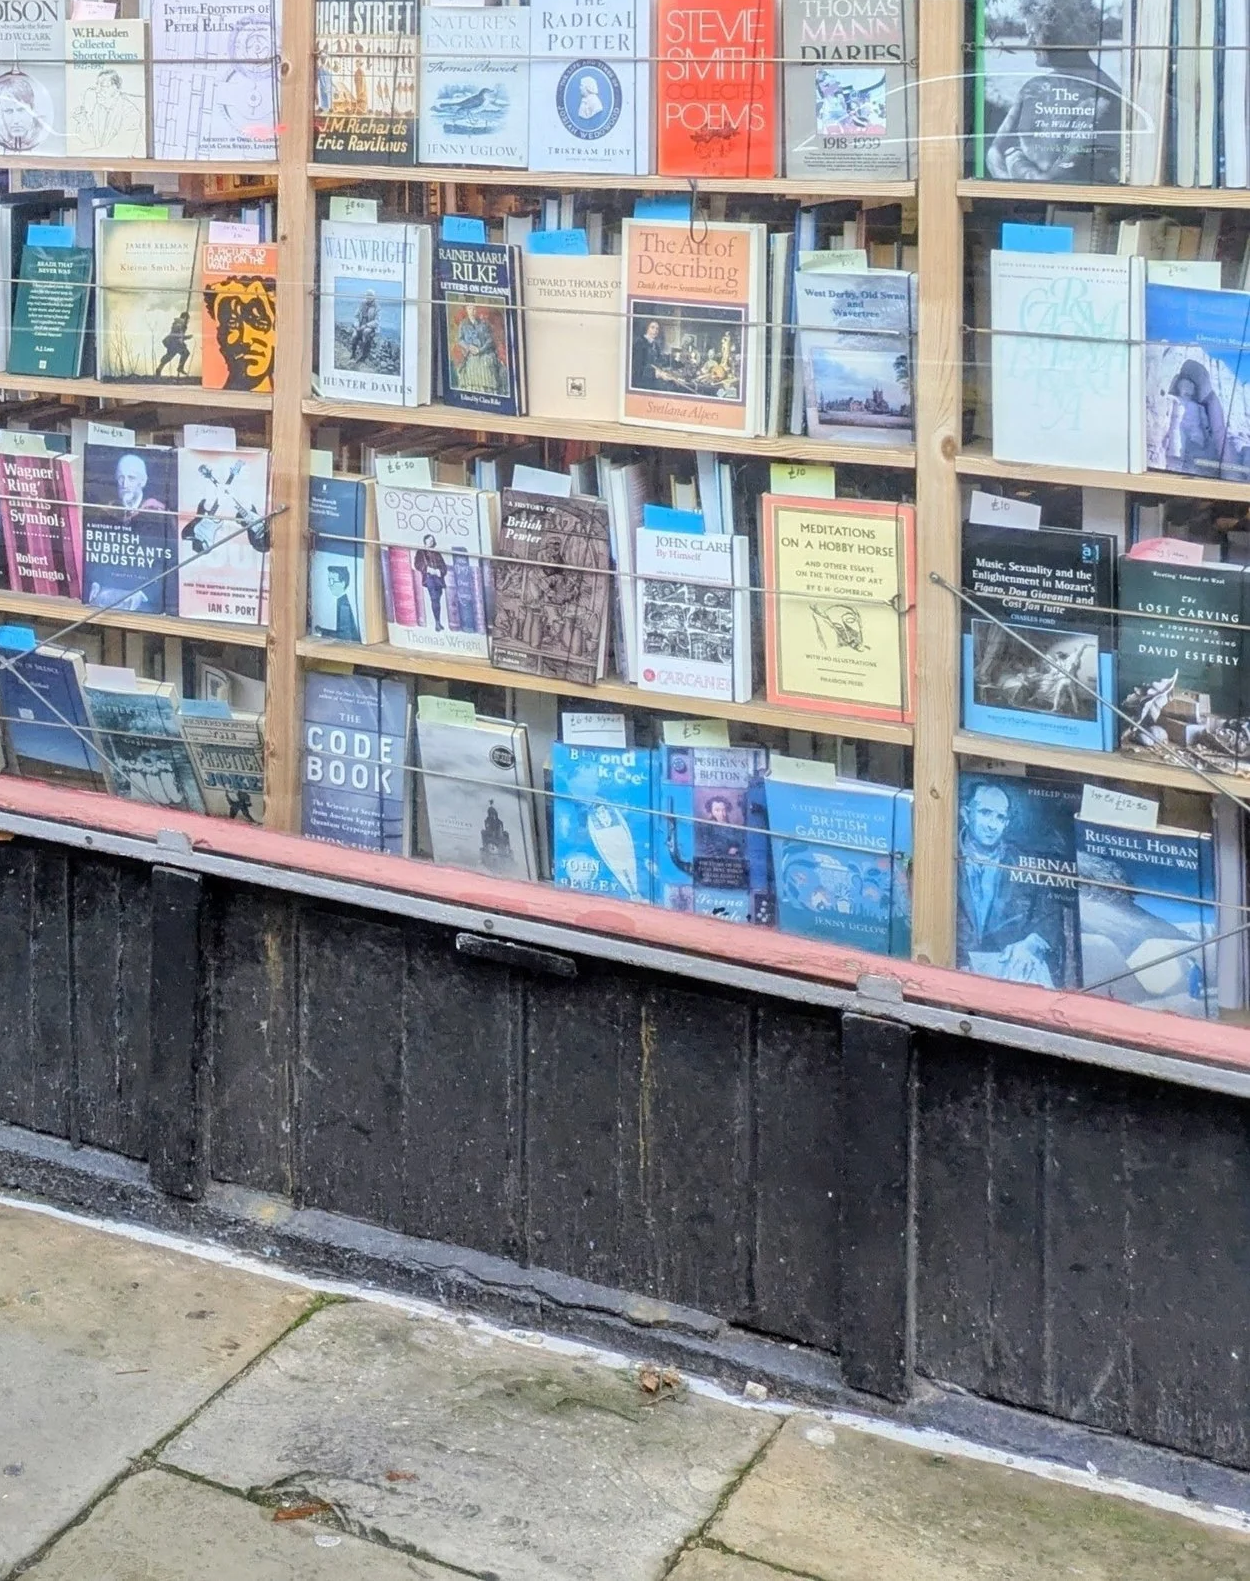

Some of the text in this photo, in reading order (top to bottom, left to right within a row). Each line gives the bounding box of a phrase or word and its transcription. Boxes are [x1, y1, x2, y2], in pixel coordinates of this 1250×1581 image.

[165, 18, 234, 33] PETER ELLIS
[316, 1, 414, 35] HIGH STREET
[431, 15, 517, 29] NATURE'S
[542, 11, 636, 29] RADICAL
[666, 9, 765, 43] STEVIE
[801, 19, 899, 42] MANN
[72, 39, 116, 49] Collected
[426, 34, 522, 49] ENGRAVER
[548, 34, 631, 51] POTTER
[73, 50, 138, 60] Shorter Poems
[666, 47, 765, 81] SMITH
[666, 83, 765, 101] COLLECTED
[1052, 88, 1079, 101] The
[666, 103, 765, 131] POEMS
[316, 134, 408, 154] Eric Ravilious
[427, 143, 518, 156] JENNY UGLOW
[547, 147, 631, 156] TRISTRAM HUNT
[325, 237, 415, 265] WAINWRIGHT
[640, 231, 738, 257] The Art of
[438, 248, 508, 265] RAINER MARIA
[451, 266, 498, 284] RILKE
[637, 256, 739, 288] Describing
[538, 288, 613, 299] THOMAS HARDY
[832, 309, 880, 318] Wavertree
[323, 376, 412, 394] HUNTER DAVIES
[788, 467, 806, 479] £10
[384, 491, 474, 517] OSCAR'S
[991, 498, 1010, 511] £10
[396, 511, 470, 537] BOOKS
[506, 515, 542, 531] British
[800, 523, 876, 540] MEDITATIONS
[86, 529, 140, 545] BRITISH
[505, 529, 541, 544] Pewter
[656, 536, 731, 553] JOHN CLARE
[86, 541, 172, 559] LUBRICANTS
[656, 549, 701, 561] By Himself
[781, 537, 894, 557] ON A HOBBY HORSE
[16, 552, 49, 566] Robert
[86, 552, 155, 568] INDUSTRY
[805, 560, 874, 574] AND OTHER ESSAYS
[810, 571, 824, 579] THE
[826, 573, 854, 583] THEORY
[856, 575, 866, 583] OF
[975, 557, 1092, 580] Music, Sexuality and the
[972, 569, 1095, 593] Enlightenment in Mozart's
[207, 603, 256, 616] IAN S. PORT
[1138, 602, 1240, 624] LOST CARVING
[406, 630, 481, 652] Thomas Wright
[1139, 644, 1240, 666] DAVID ESTERLY
[339, 712, 362, 724] THE
[682, 721, 701, 739] £5
[307, 726, 393, 763] CODE
[307, 756, 392, 794] BOOK
[700, 770, 740, 781] BUTTON
[811, 814, 868, 832] BRITISH
[795, 825, 888, 848] GARDENING
[1084, 829, 1199, 858] RUSSELL HOBAN
[1086, 844, 1199, 870] THE TROKEVILLE WAY
